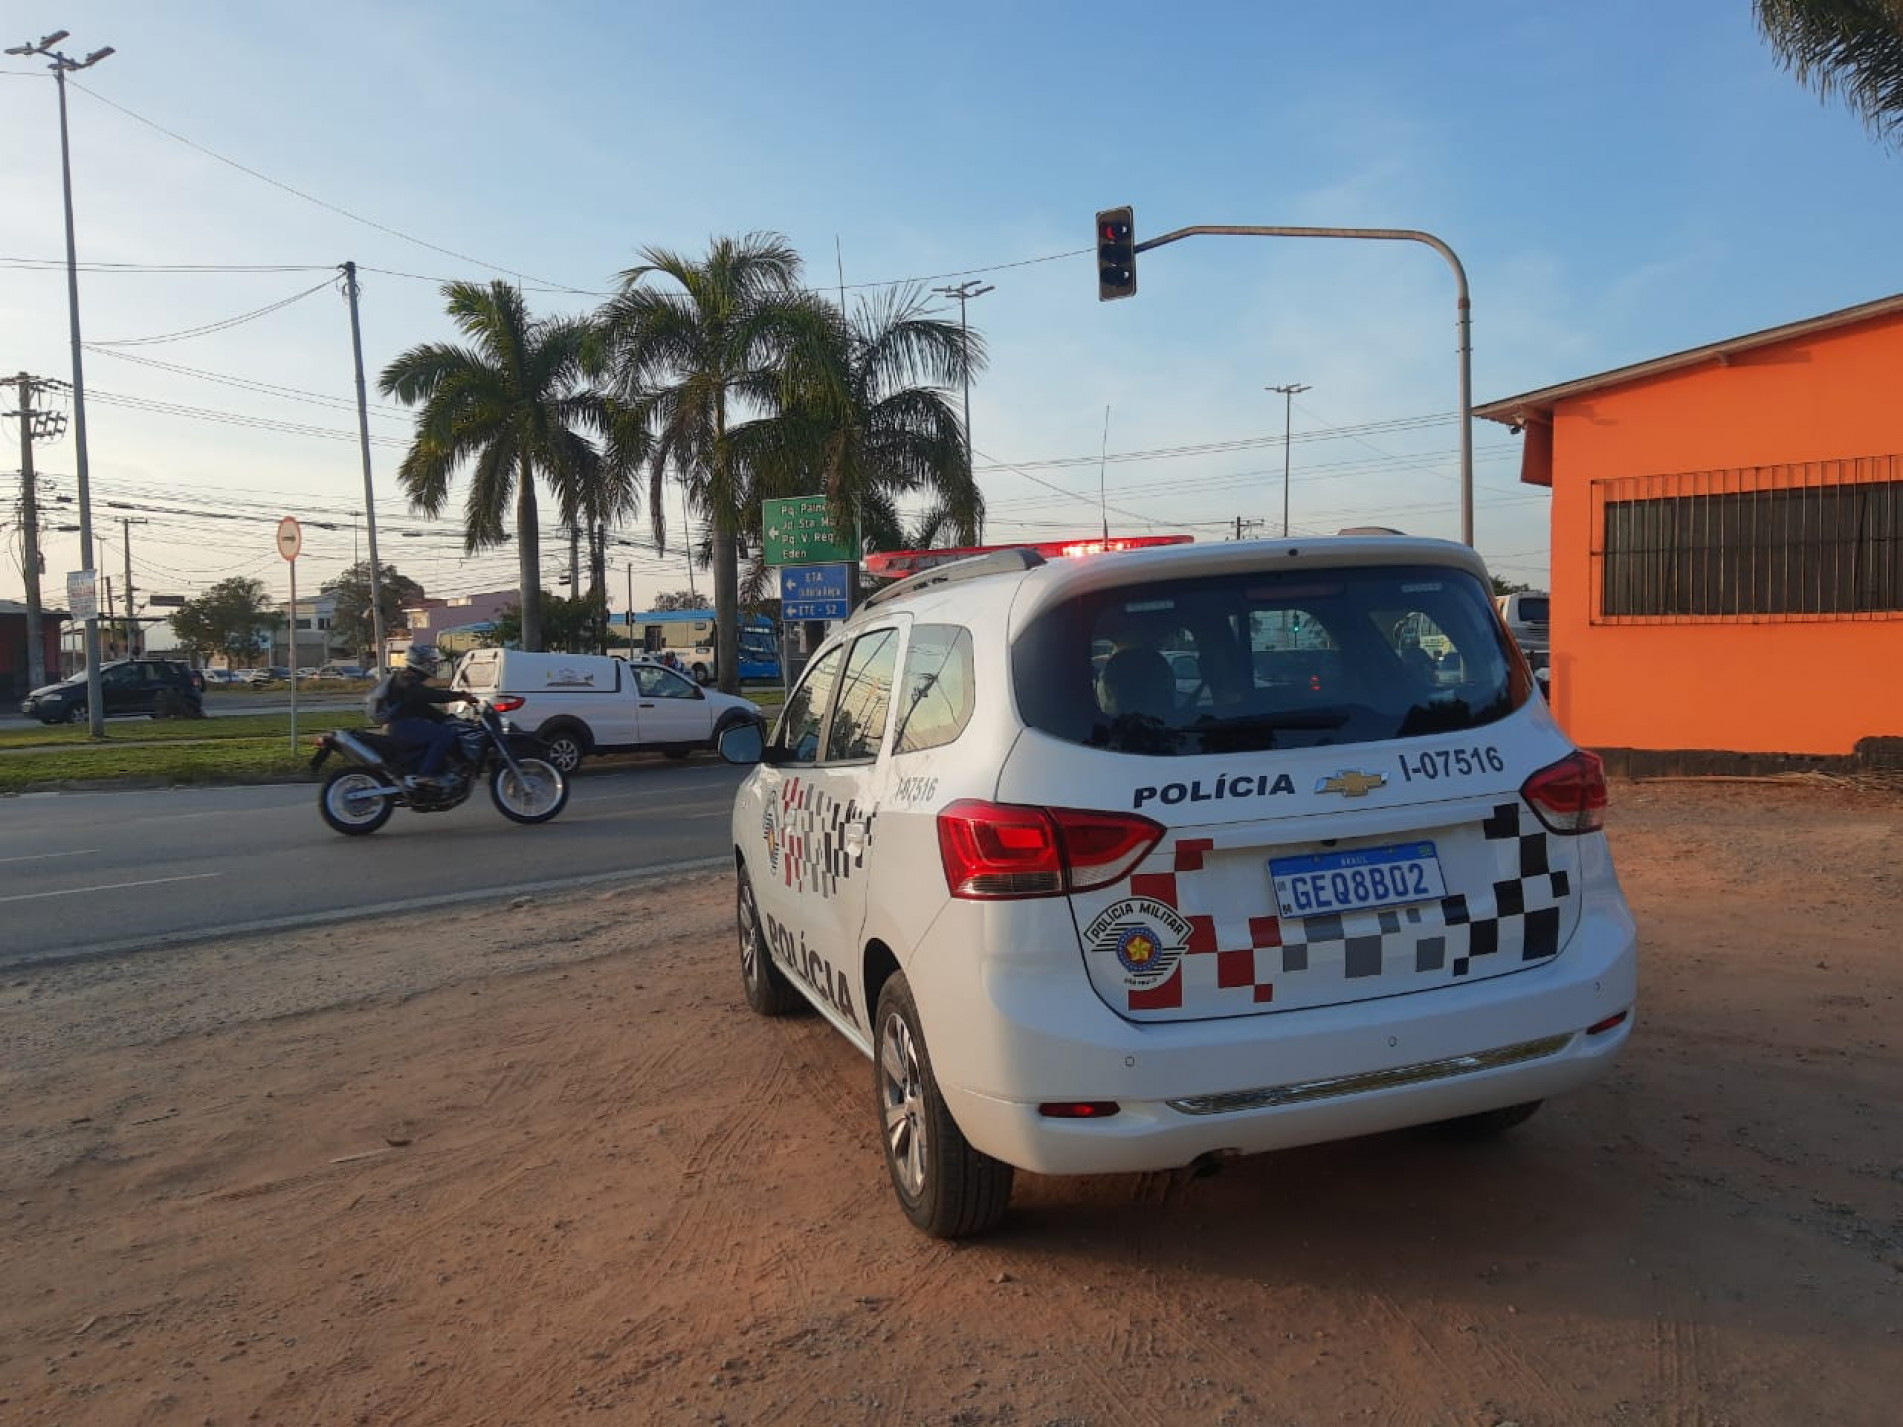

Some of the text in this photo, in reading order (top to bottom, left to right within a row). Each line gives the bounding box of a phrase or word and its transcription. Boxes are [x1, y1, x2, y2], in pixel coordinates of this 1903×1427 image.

[1398, 746, 1504, 782] I-07516
[1132, 772, 1296, 809] POLÍCIA
[1291, 863, 1430, 911] GEQ8B02
[1090, 902, 1185, 939] POLÍCIA MILITAR
[767, 912, 862, 1031] POLÍCIA
